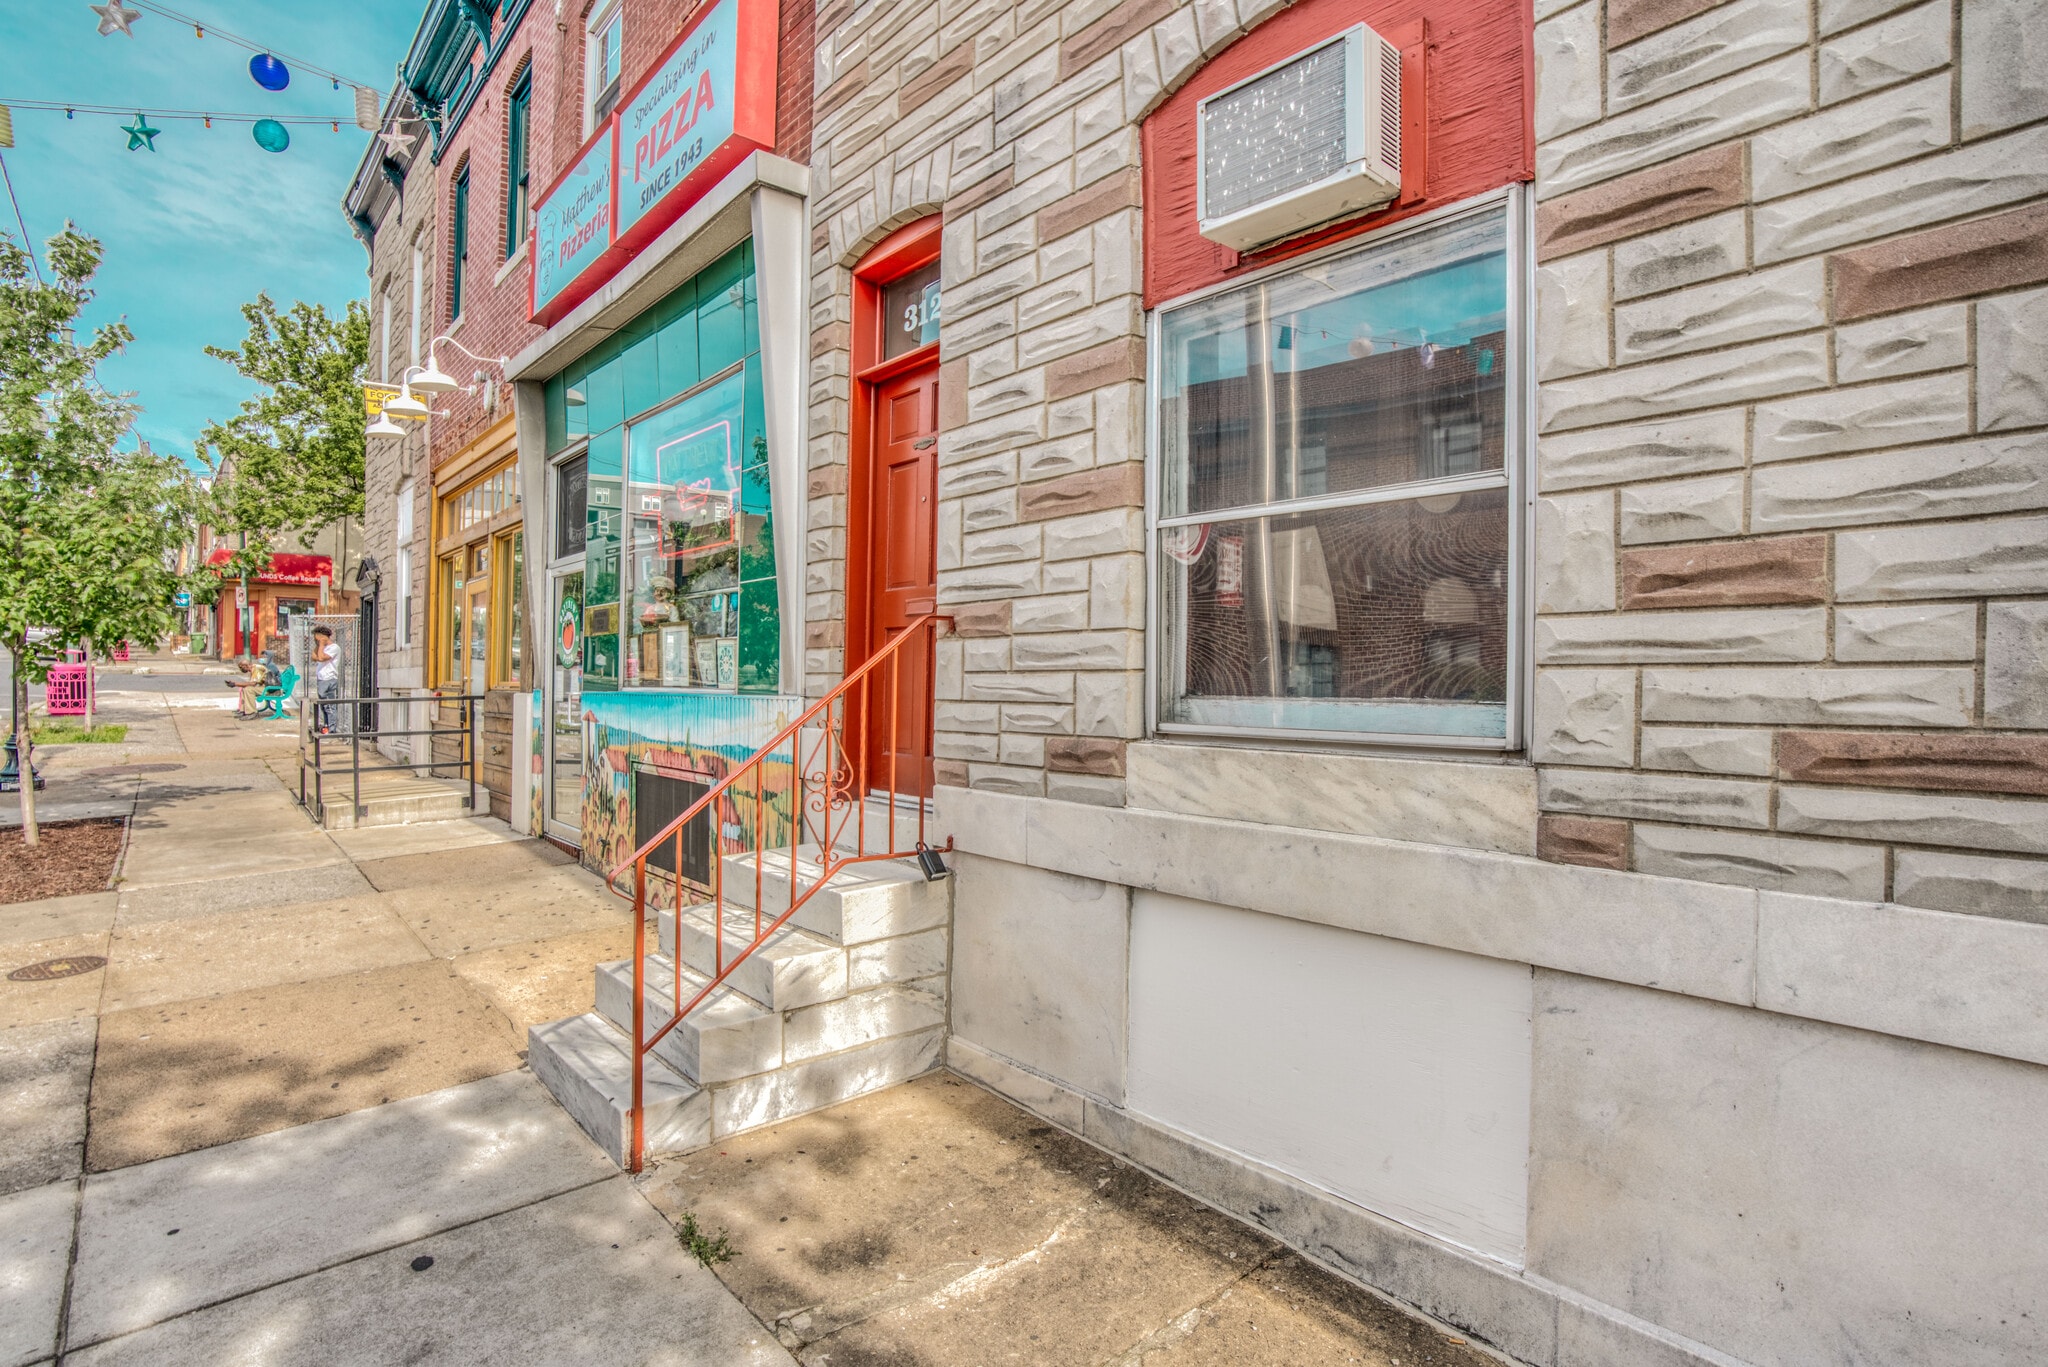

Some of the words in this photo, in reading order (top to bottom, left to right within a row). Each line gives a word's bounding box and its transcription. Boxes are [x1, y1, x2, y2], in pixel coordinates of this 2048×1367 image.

[634, 47, 698, 130] Specializing
[701, 30, 717, 55] in
[634, 68, 715, 184] PIZZA
[561, 163, 610, 233] Matthew's
[640, 166, 671, 210] SINCE
[675, 137, 703, 177] 1943
[559, 202, 609, 269] Pizzeria
[903, 292, 941, 332] 312
